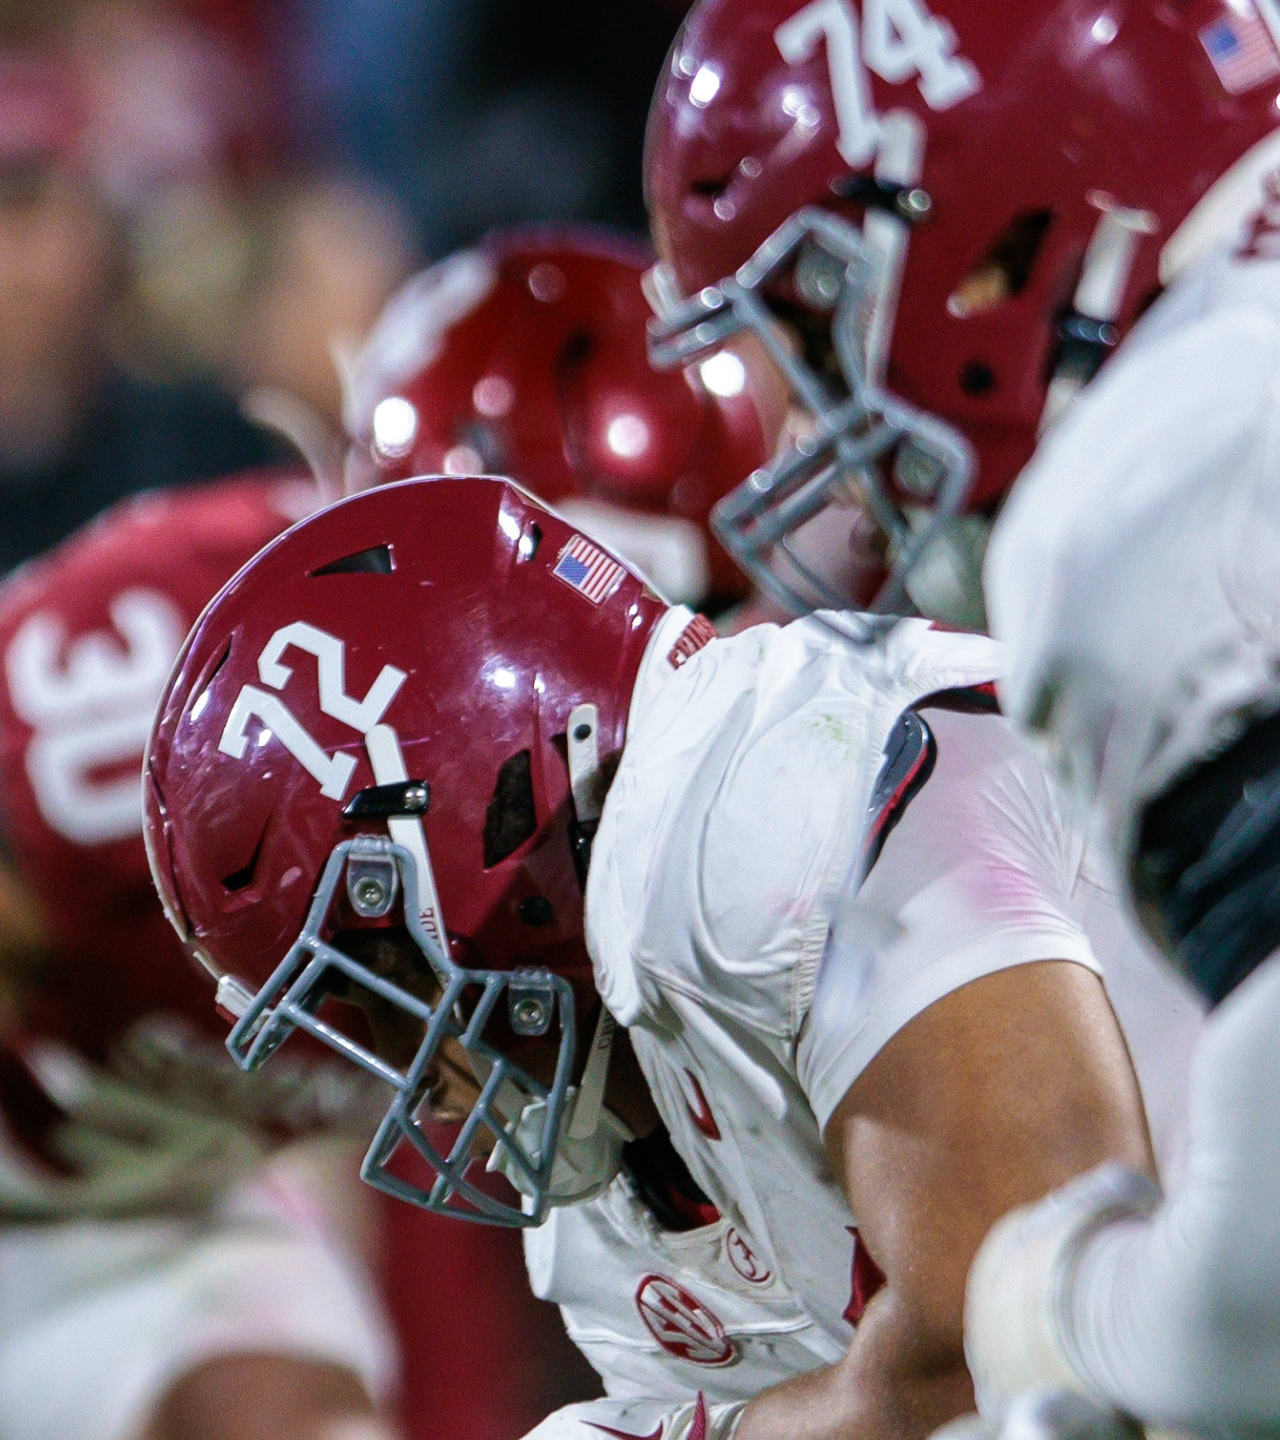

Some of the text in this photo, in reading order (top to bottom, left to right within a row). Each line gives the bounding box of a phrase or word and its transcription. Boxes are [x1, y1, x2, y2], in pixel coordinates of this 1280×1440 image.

[775, 0, 982, 168] 74
[7, 588, 188, 846] 30
[218, 620, 408, 801] 72
